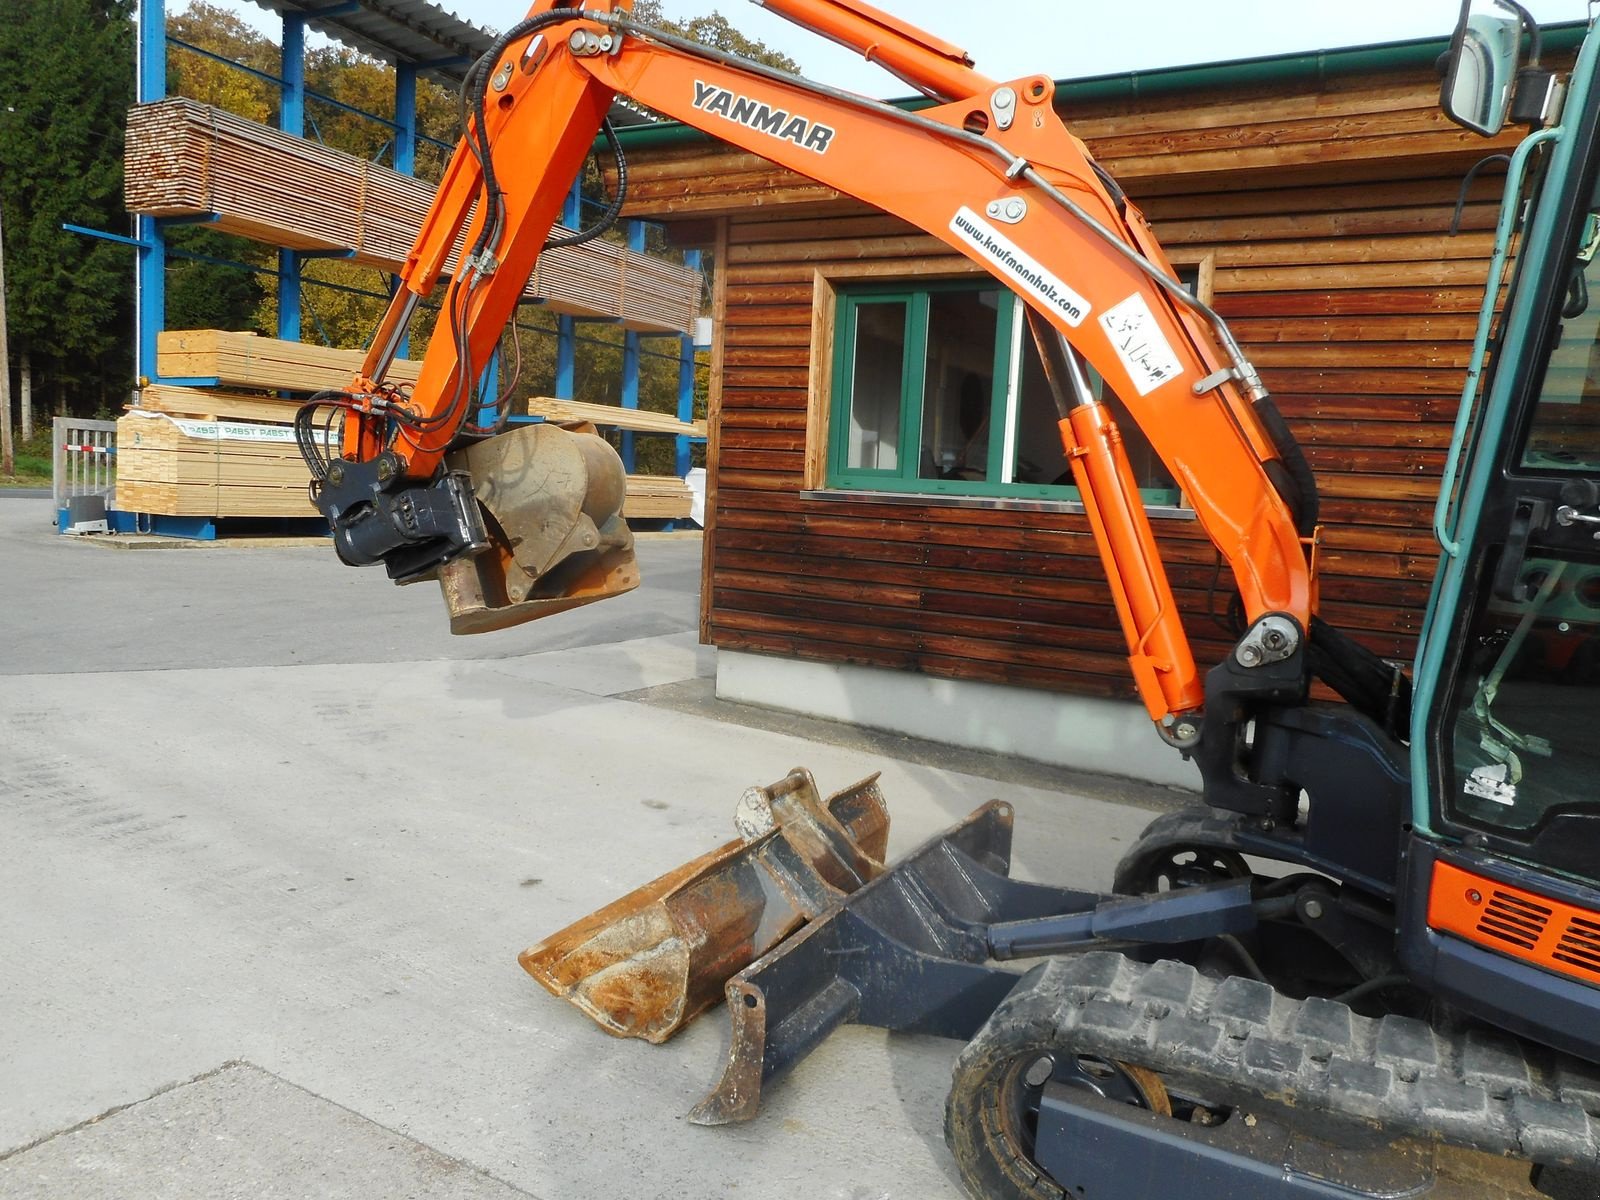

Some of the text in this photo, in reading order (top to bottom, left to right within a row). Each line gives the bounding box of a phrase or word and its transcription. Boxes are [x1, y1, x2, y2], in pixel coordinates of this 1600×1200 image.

[692, 80, 835, 154] YANMAR
[955, 215, 1081, 319] www.kaufmannholz.com
[224, 427, 256, 436] PABST
[259, 429, 289, 437] PABST
